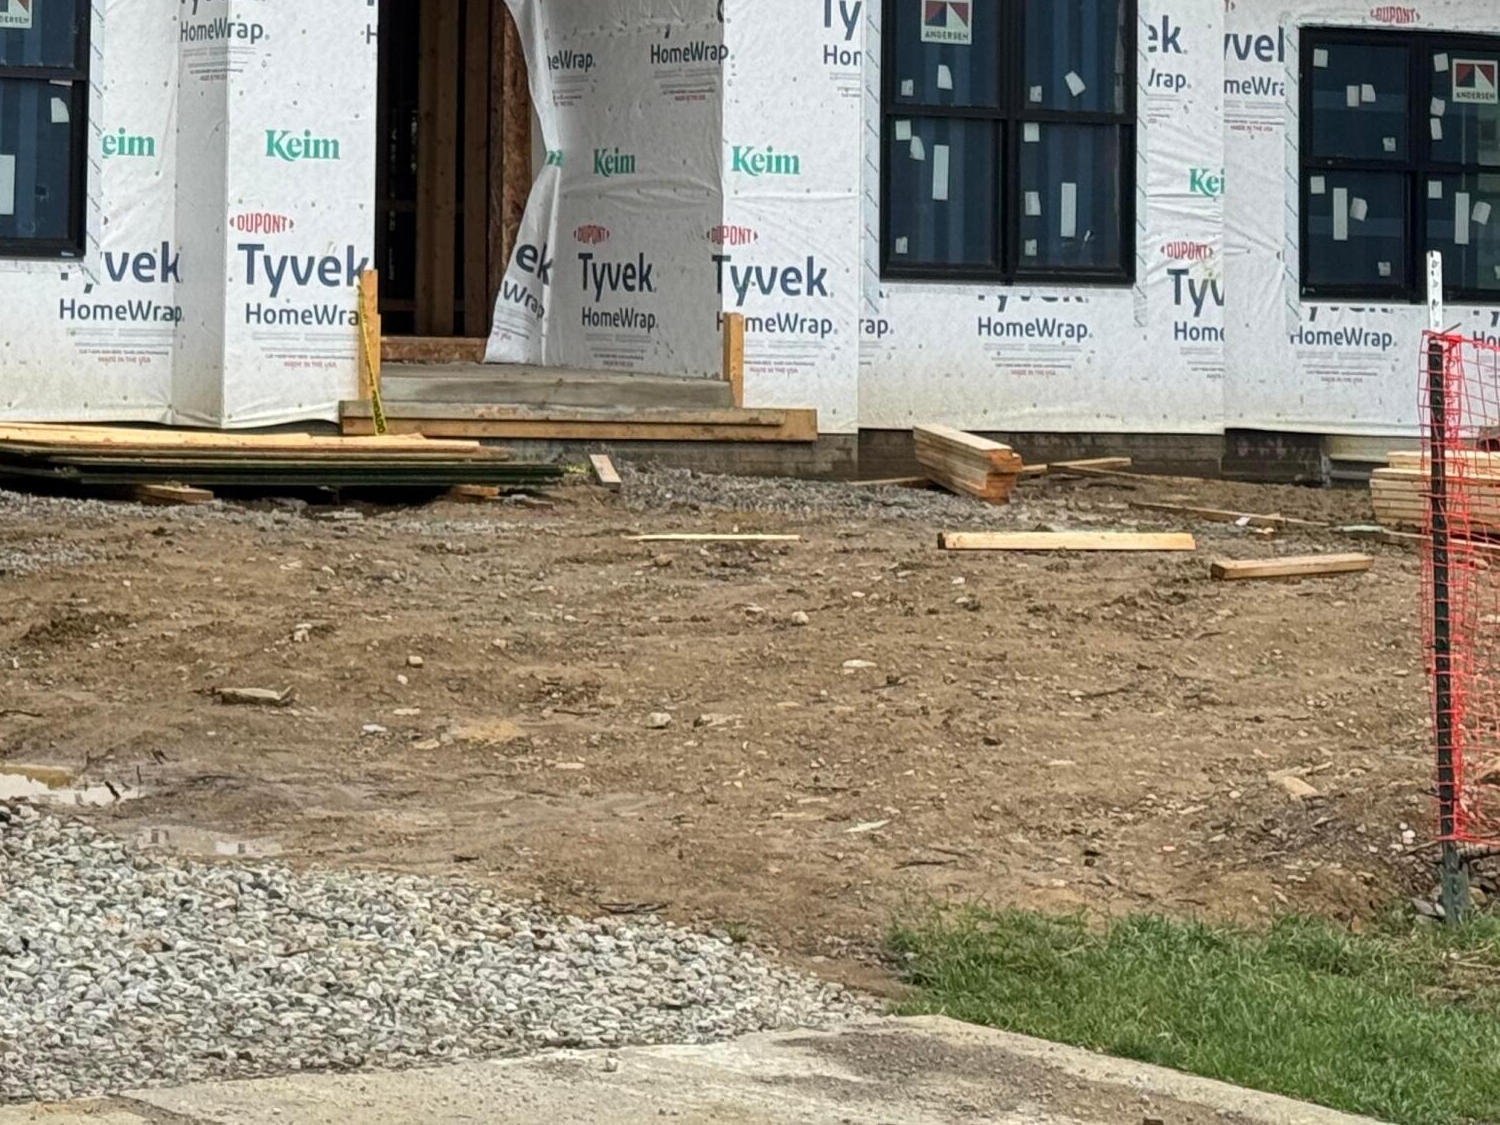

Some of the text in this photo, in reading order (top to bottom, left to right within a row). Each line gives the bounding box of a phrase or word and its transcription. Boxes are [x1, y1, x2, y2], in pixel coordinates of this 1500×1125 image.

[1375, 6, 1416, 24] DUPONT
[180, 17, 264, 45] HomeWrap
[650, 40, 729, 65] HomeWrap
[102, 128, 156, 159] eim
[265, 129, 341, 162] Keim
[593, 146, 636, 177] Keim
[731, 145, 800, 177] Keim
[1187, 168, 1225, 197] Kei
[236, 213, 288, 234] DUPONT
[710, 224, 753, 246] DUPONT
[101, 241, 181, 284] vek
[1166, 241, 1208, 260] DUPONT
[237, 243, 369, 297] Tyvek
[577, 251, 653, 303] Tyvek
[711, 255, 829, 307] Tyvek
[59, 298, 183, 327] HomeWrap
[245, 303, 359, 326] HomeWra
[582, 306, 656, 334] HomeWrap
[977, 316, 1089, 343] HomeWrap
